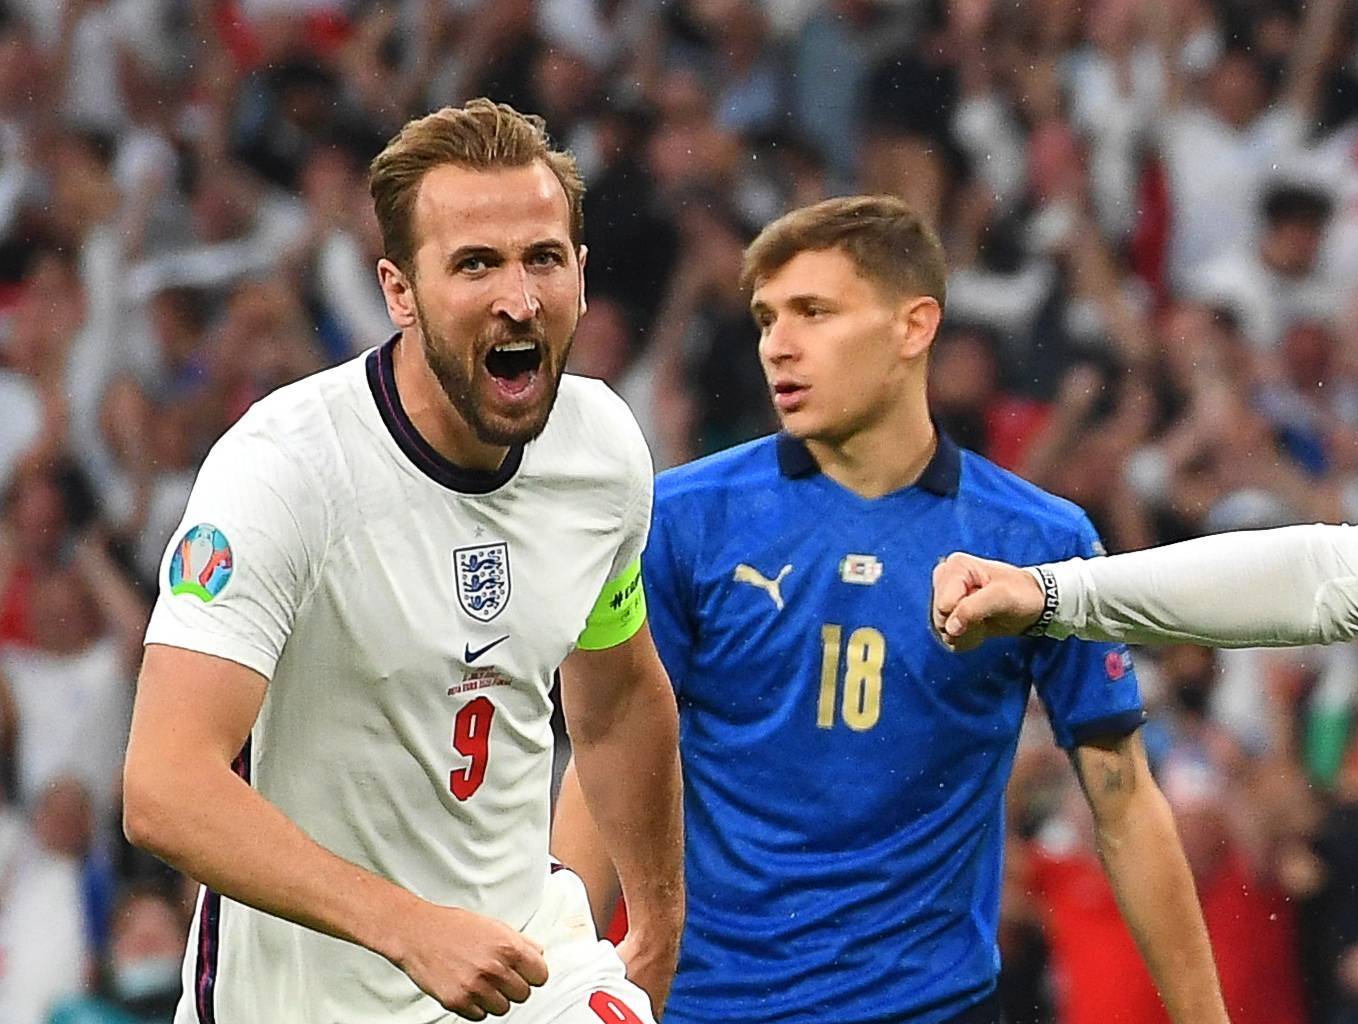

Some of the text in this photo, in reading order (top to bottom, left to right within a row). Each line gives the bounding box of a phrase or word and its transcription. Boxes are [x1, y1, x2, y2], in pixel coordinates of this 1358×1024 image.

[1042, 569, 1059, 608] RACI
[816, 623, 886, 731] 18
[450, 696, 494, 801] 9
